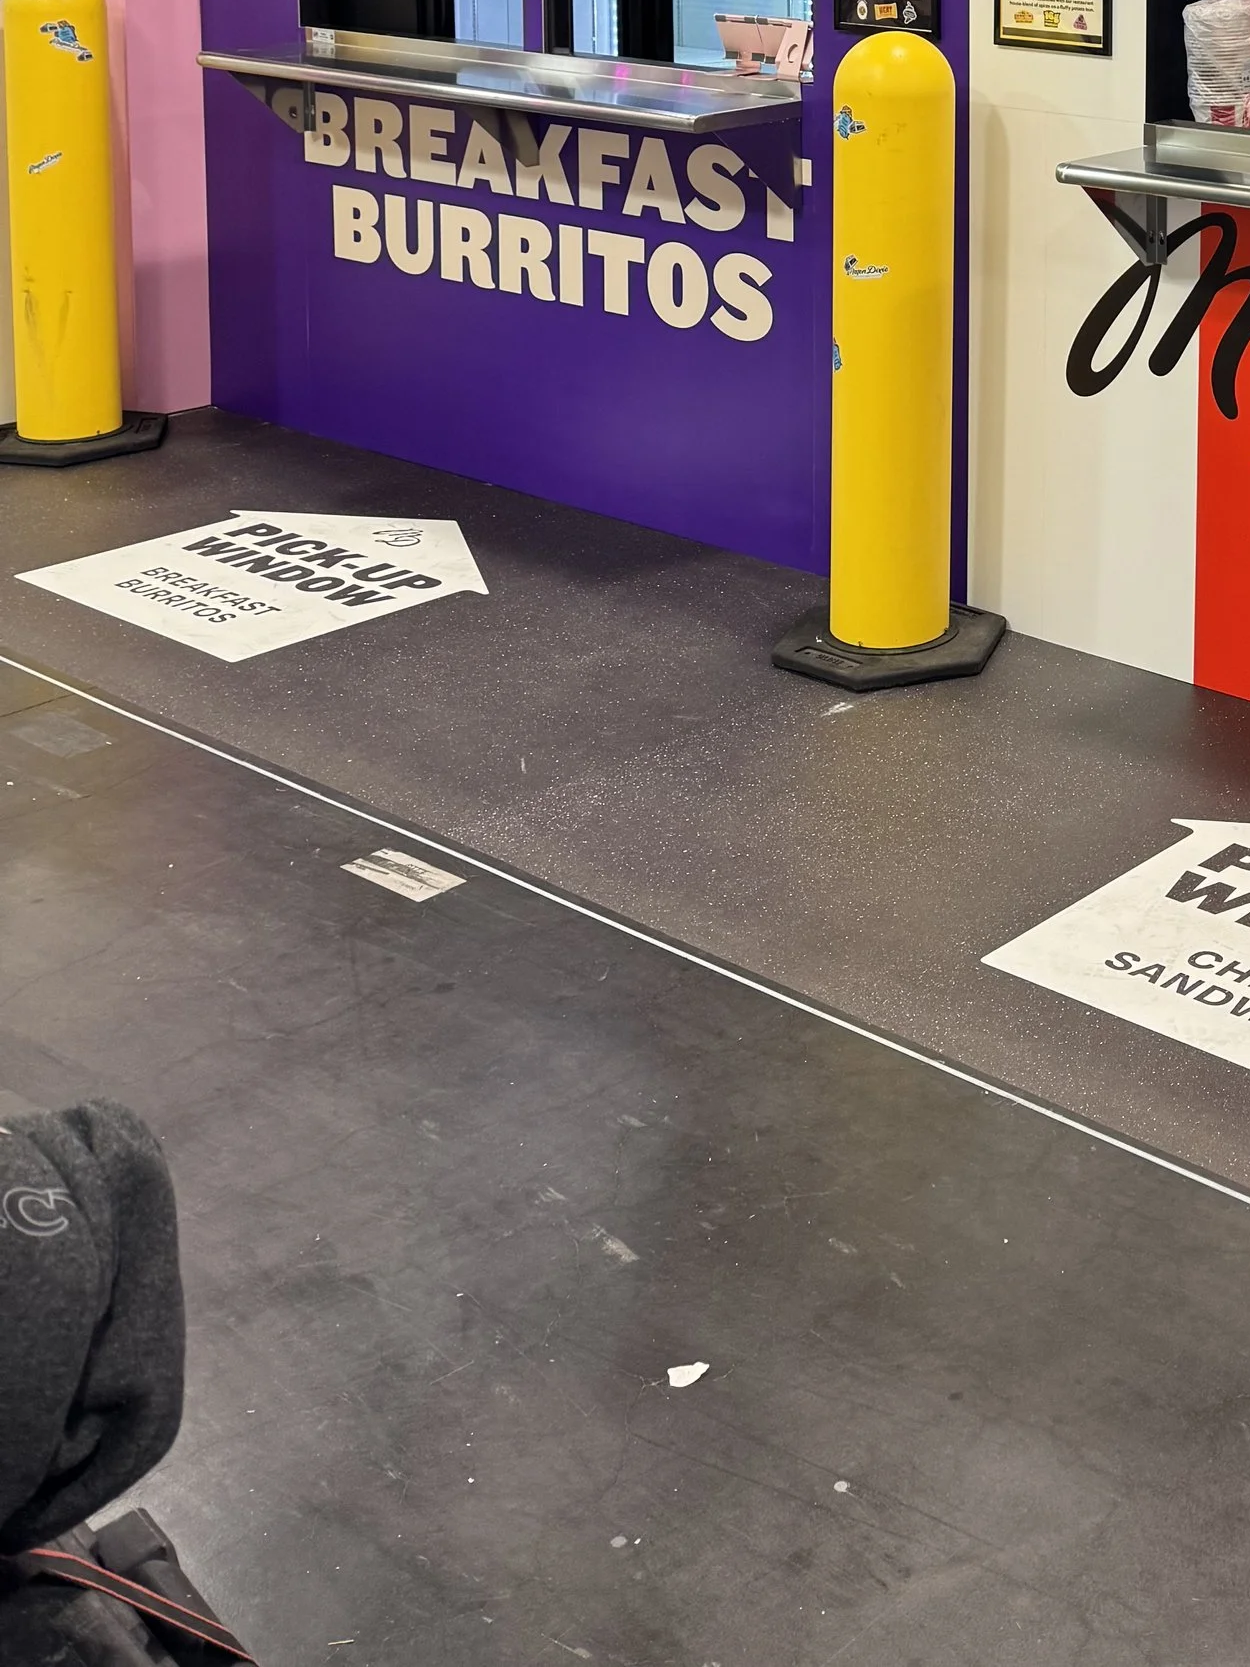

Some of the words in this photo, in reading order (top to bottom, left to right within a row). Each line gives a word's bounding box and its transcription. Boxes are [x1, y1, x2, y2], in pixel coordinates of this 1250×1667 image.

[304, 91, 812, 242] BREAKFAST
[332, 185, 773, 342] BURRITOS
[140, 566, 282, 616] BREAKFAST
[182, 536, 397, 608] WINDOW
[223, 522, 443, 591] PICK-UP
[114, 579, 237, 624] BURRITOS
